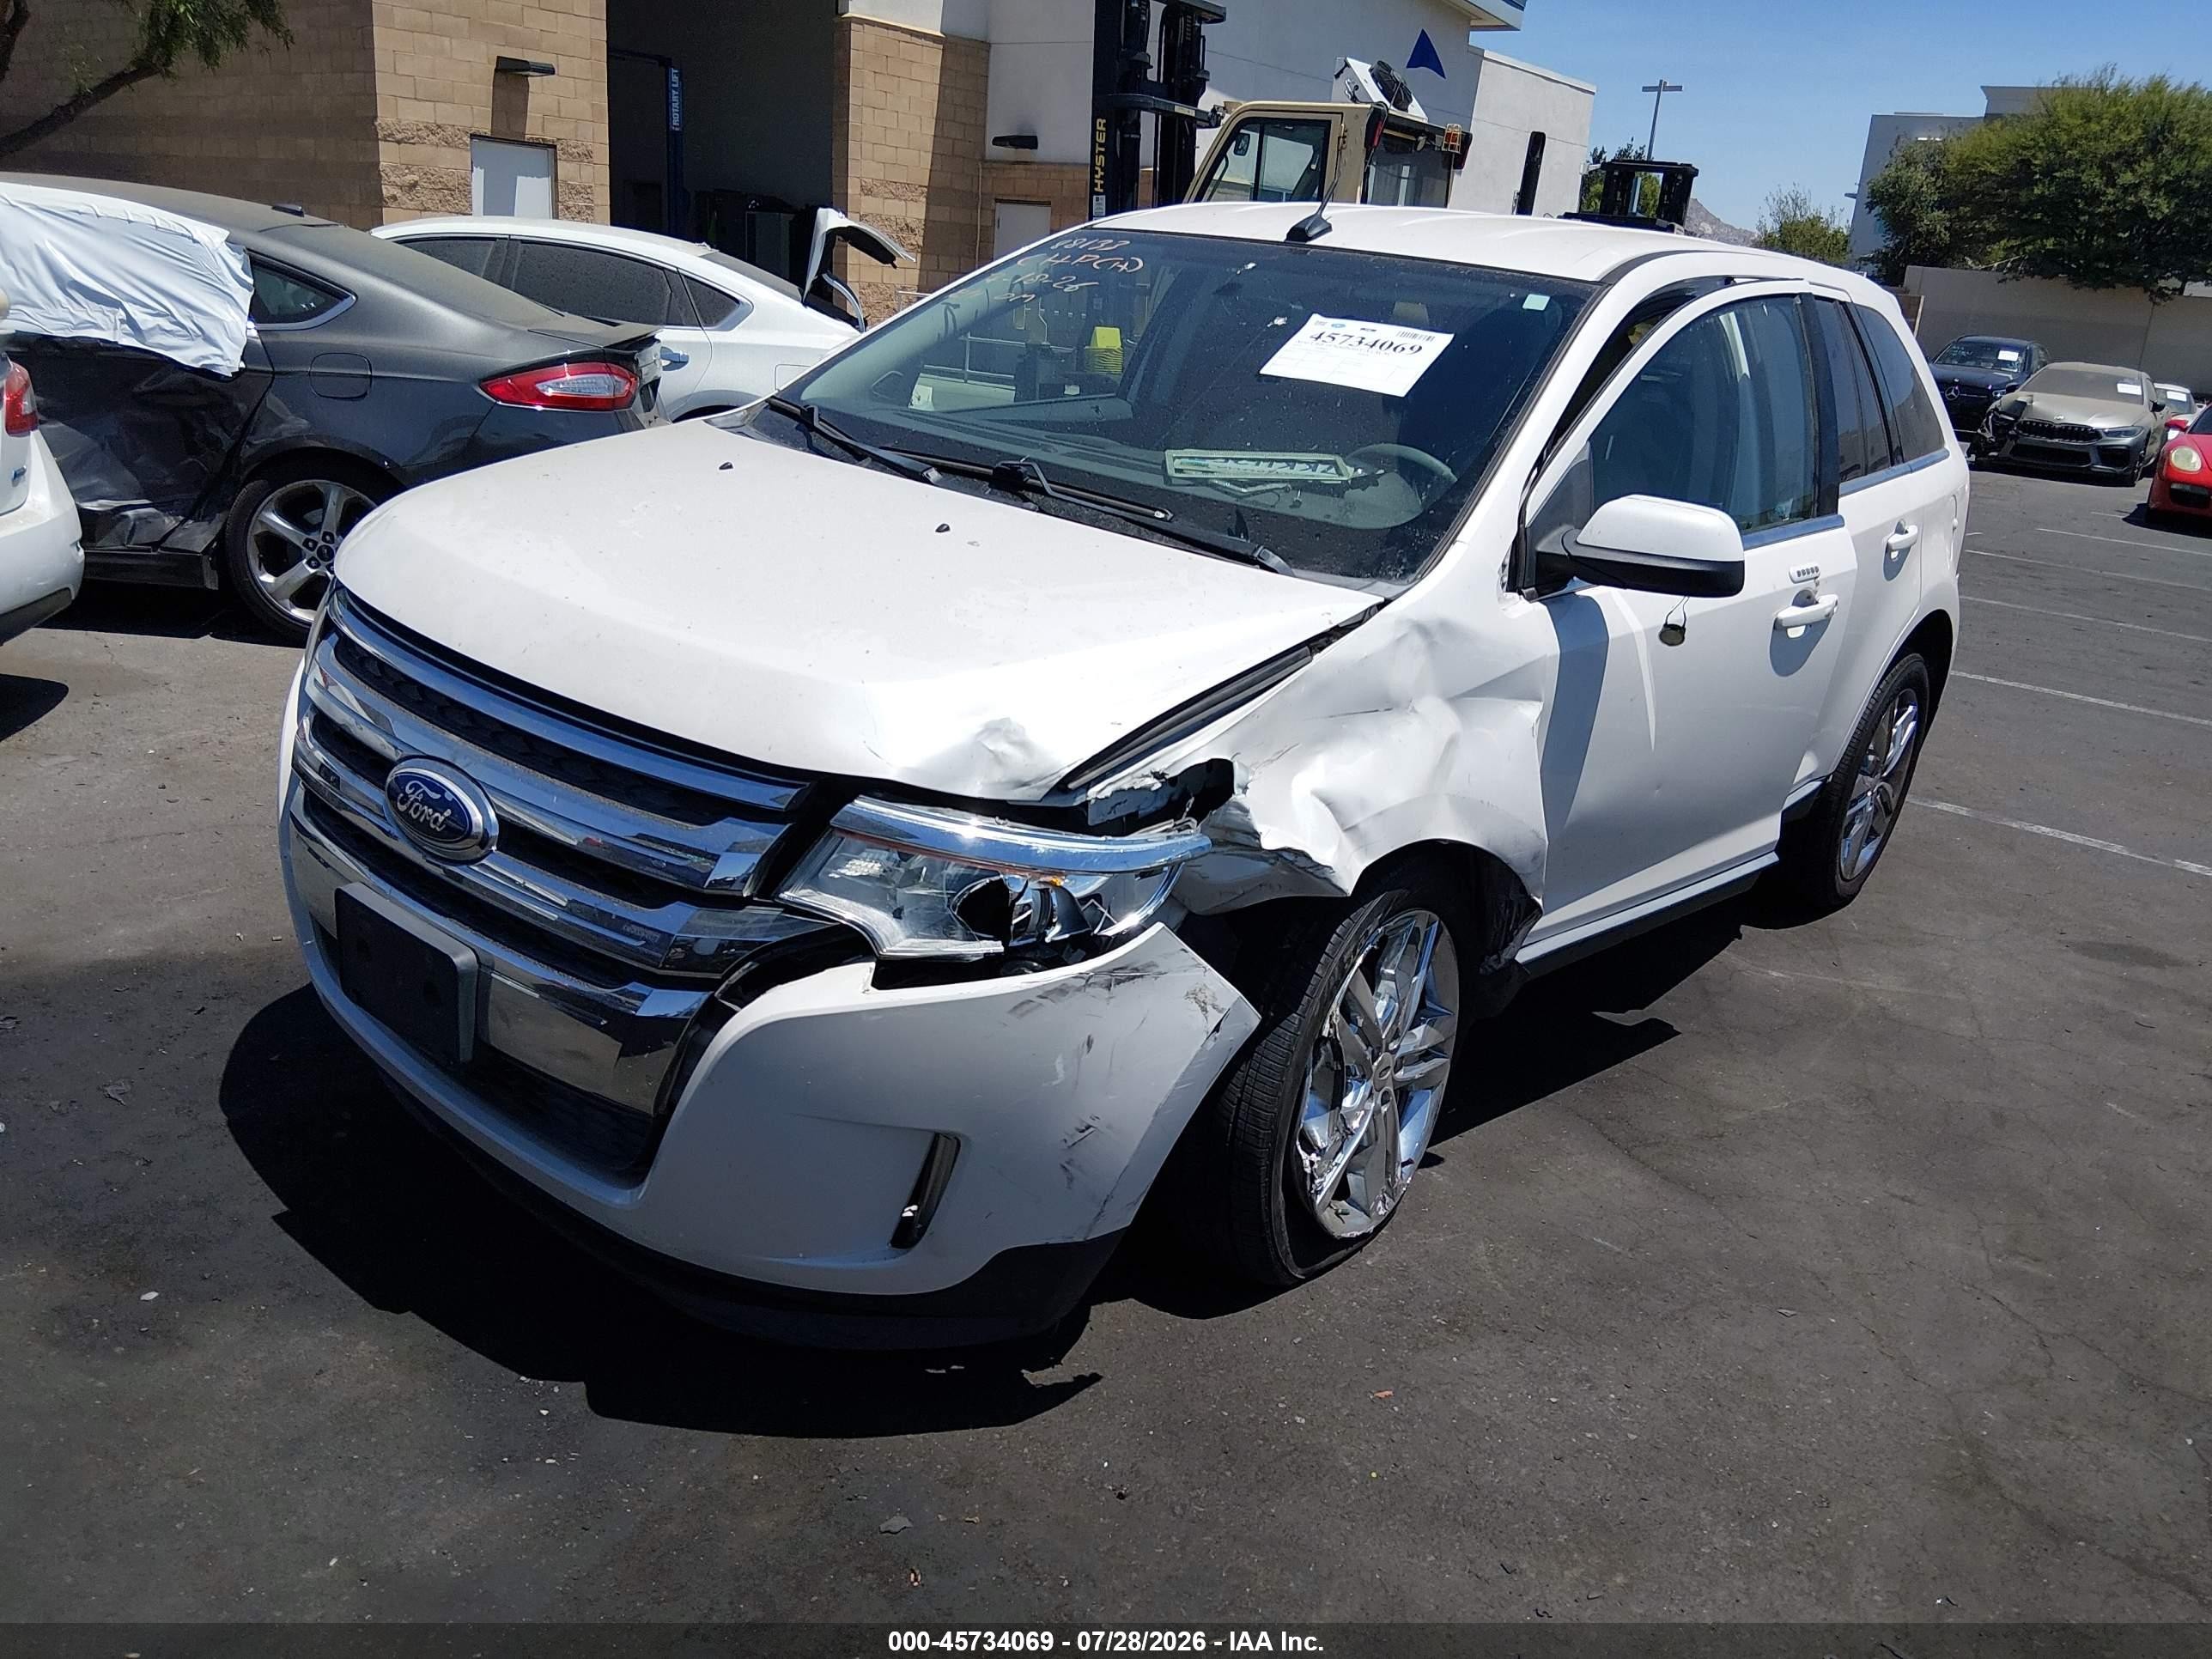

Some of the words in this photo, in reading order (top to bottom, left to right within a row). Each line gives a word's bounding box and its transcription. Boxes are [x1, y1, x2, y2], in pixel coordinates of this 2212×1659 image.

[672, 89, 680, 125] ROTARY
[1094, 118, 1107, 193] HYSTER
[1310, 330, 1423, 356] 45734069
[397, 780, 452, 832] Ford
